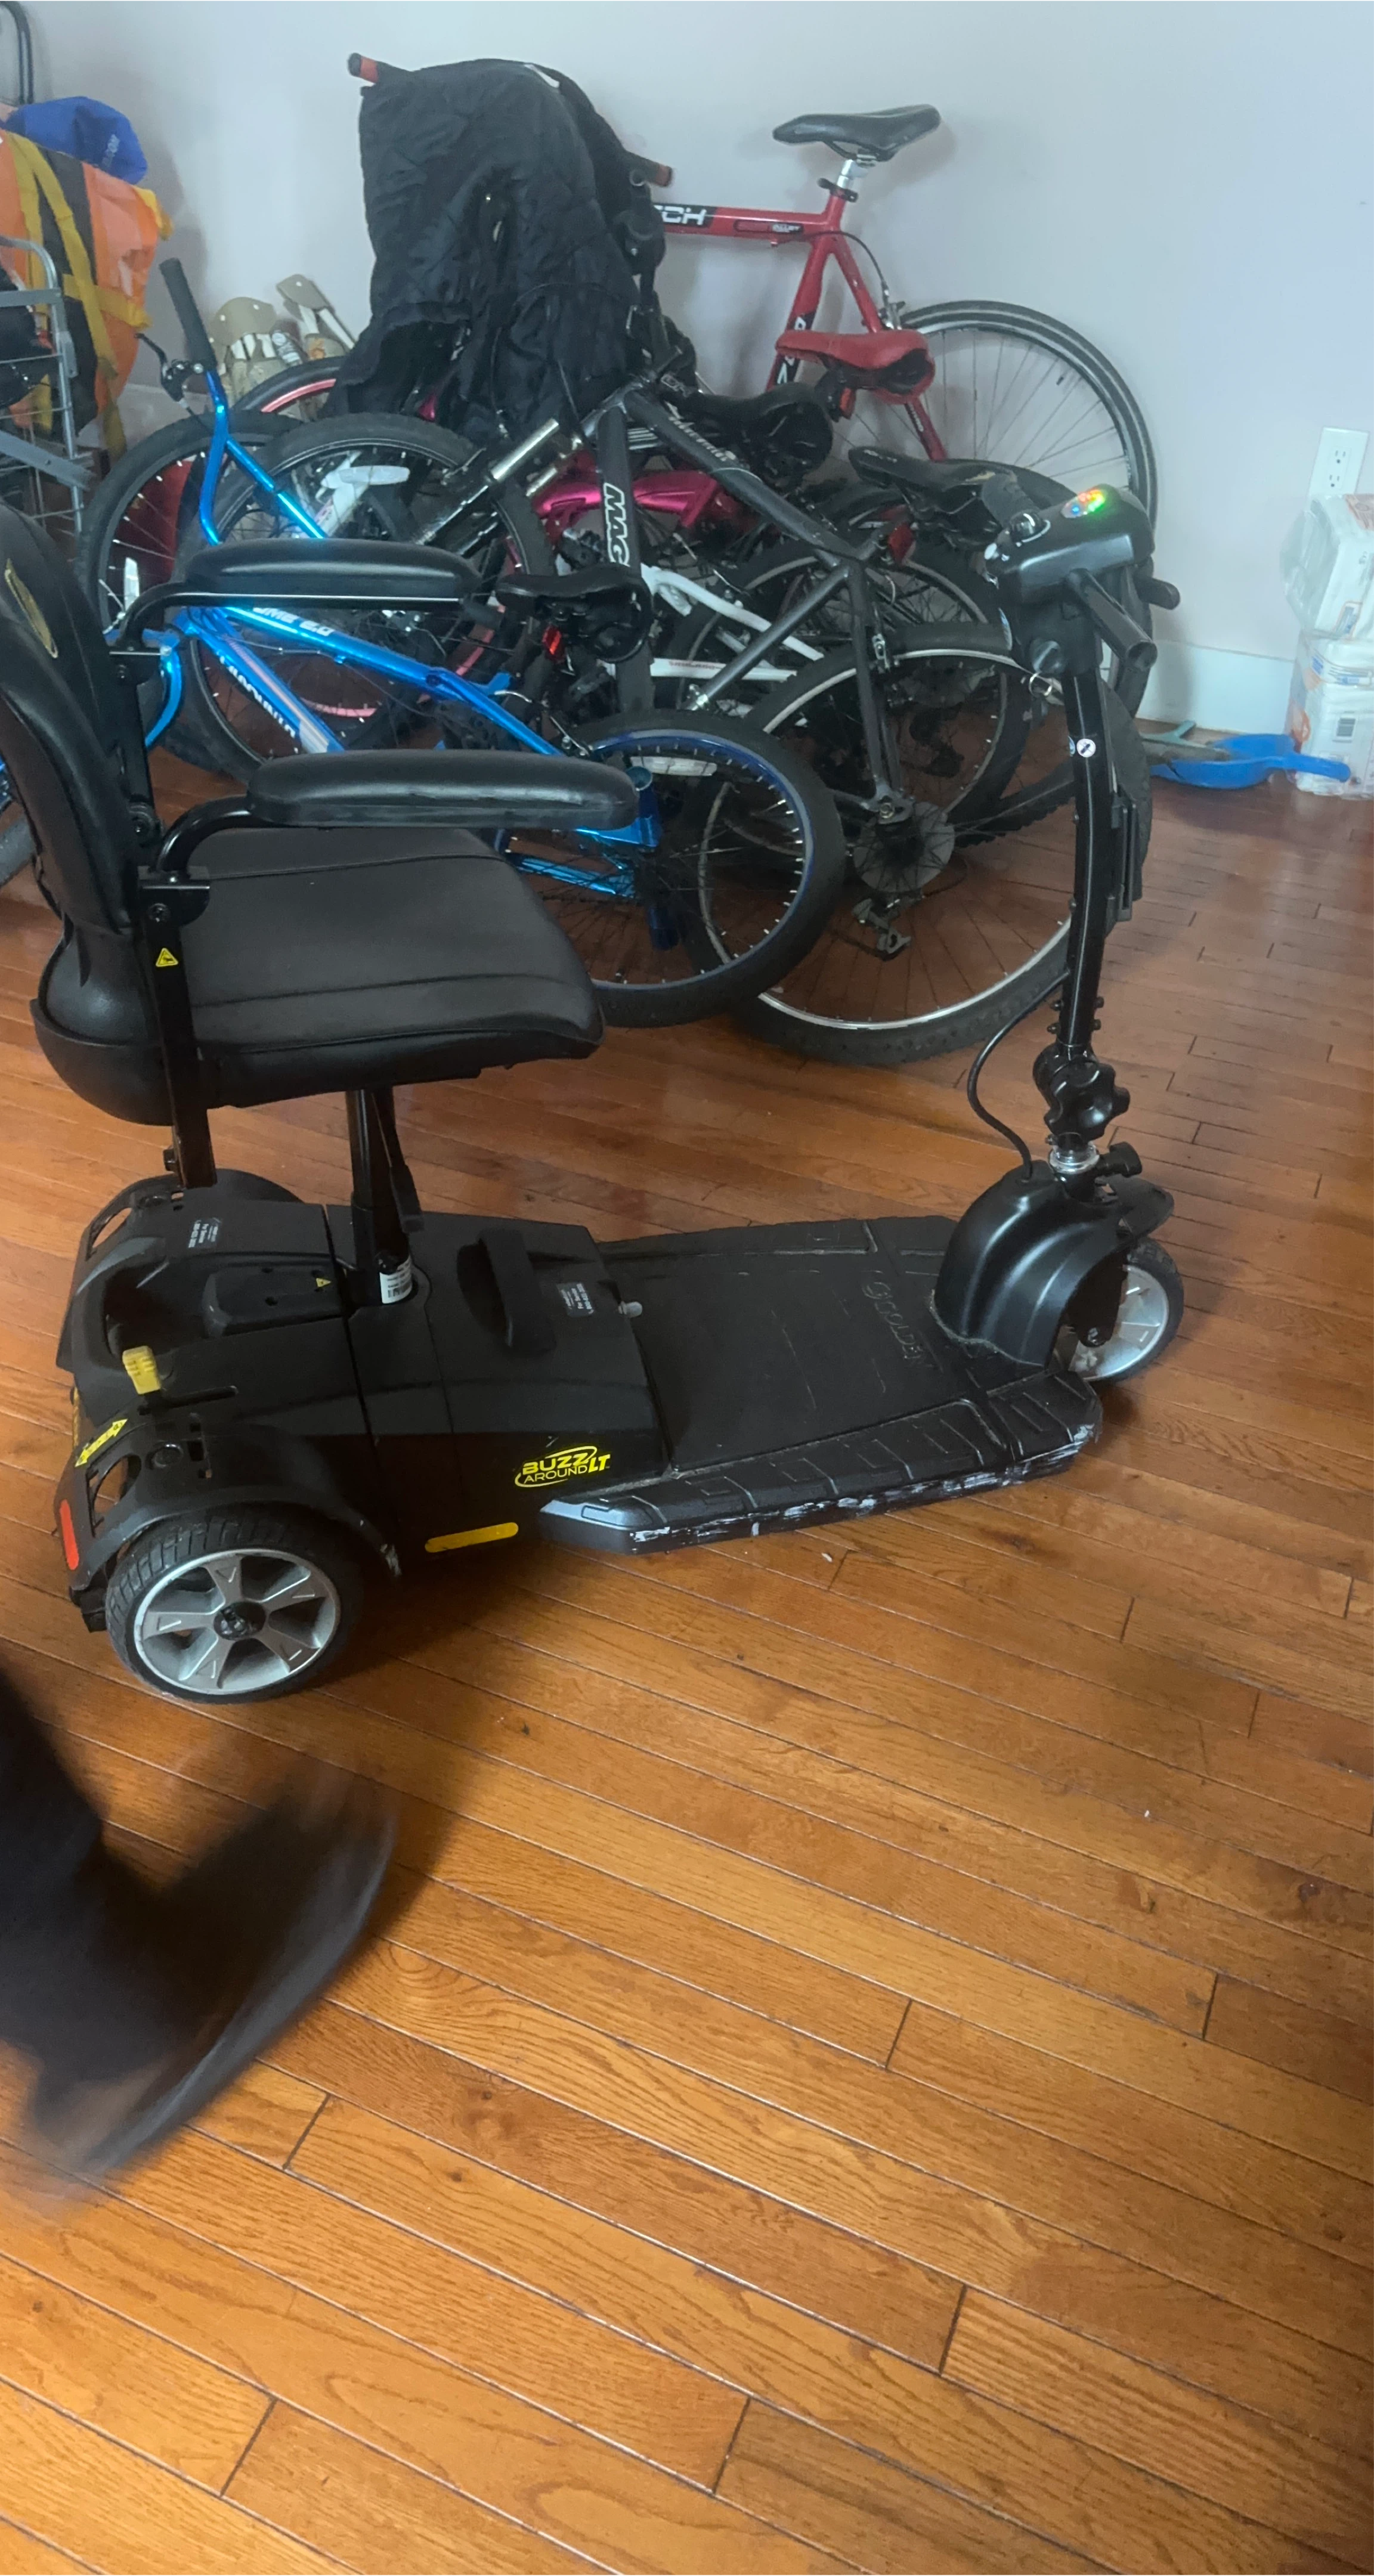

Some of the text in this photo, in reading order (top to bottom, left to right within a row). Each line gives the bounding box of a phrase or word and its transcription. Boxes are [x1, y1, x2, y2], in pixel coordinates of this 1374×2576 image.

[522, 1452, 589, 1475] BUZZ
[524, 1454, 611, 1484] AROUND LT
